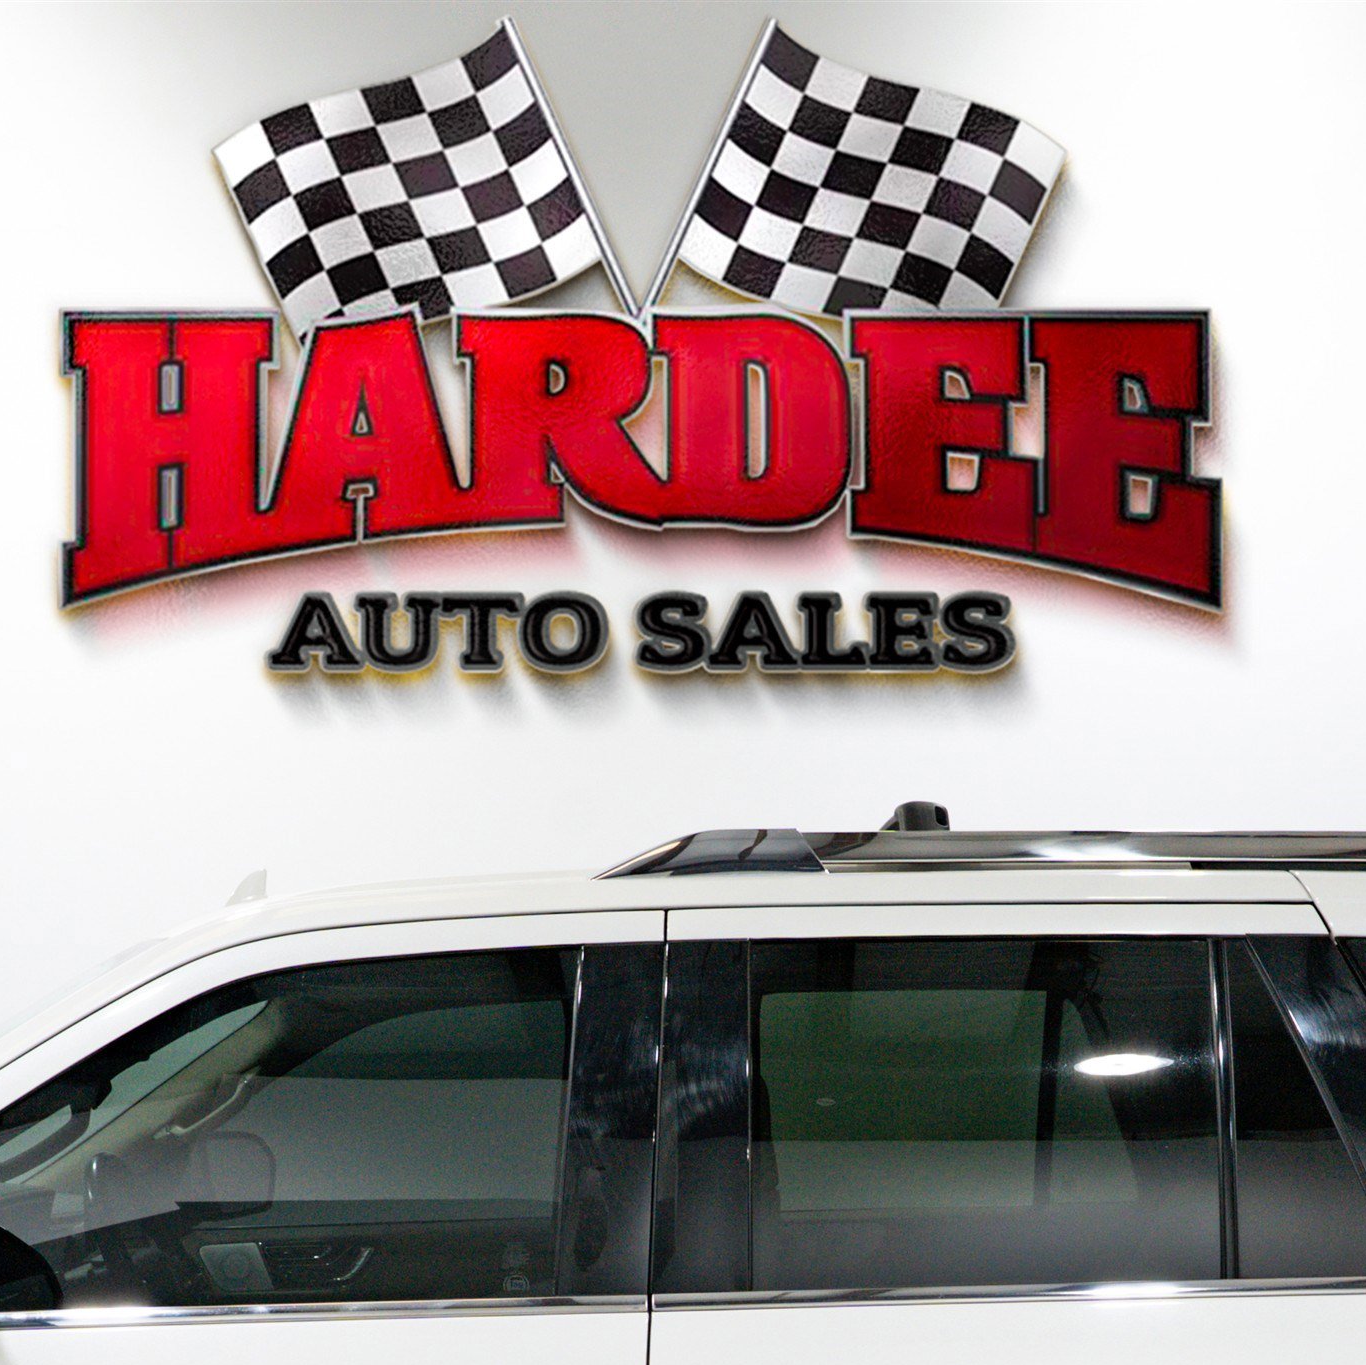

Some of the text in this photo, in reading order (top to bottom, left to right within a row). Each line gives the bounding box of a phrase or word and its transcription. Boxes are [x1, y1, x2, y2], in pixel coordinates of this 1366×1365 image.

[60, 308, 1223, 608] HARDEE
[267, 591, 1017, 672] AUTO SALES
